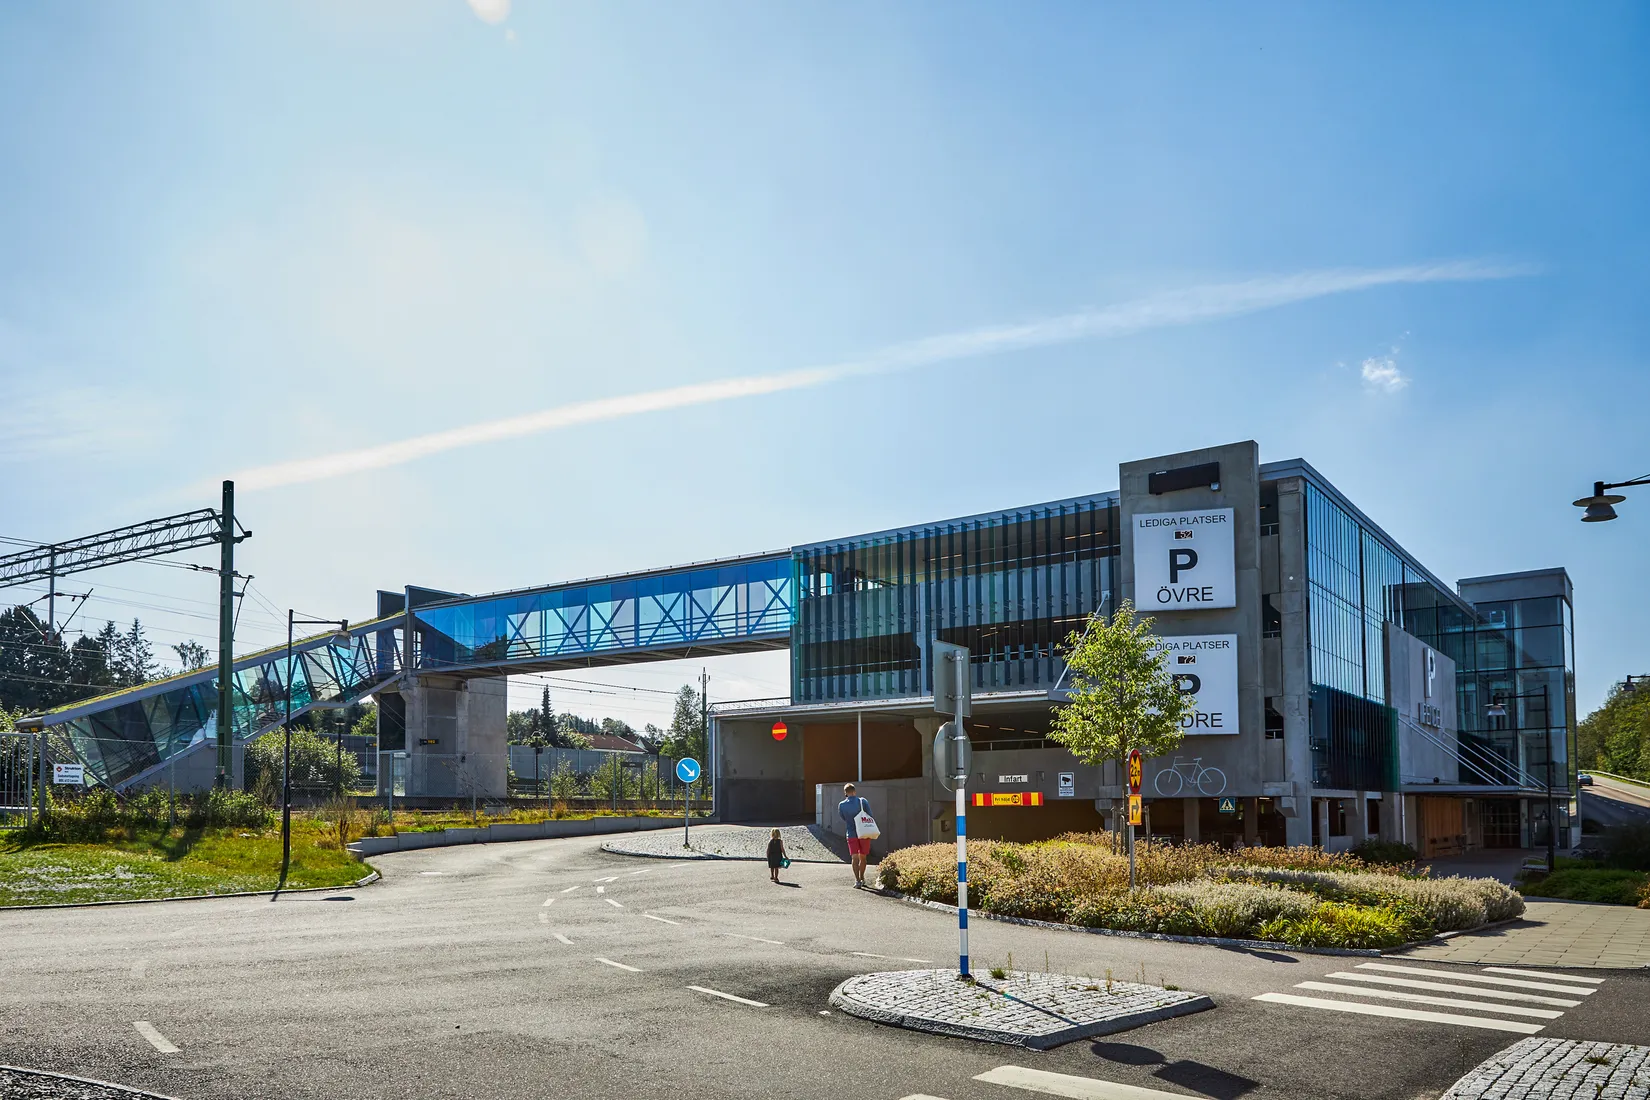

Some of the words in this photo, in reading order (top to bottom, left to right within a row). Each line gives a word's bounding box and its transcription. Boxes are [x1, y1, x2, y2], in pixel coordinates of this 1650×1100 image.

[1140, 517, 1177, 528] LEDIGA
[1179, 515, 1227, 525] PLATSER
[1169, 548, 1198, 583] P
[1157, 586, 1214, 603] ÖVRE
[1144, 642, 1180, 651] EDIGA
[1182, 640, 1230, 650] PLATSER
[1423, 647, 1436, 698] P
